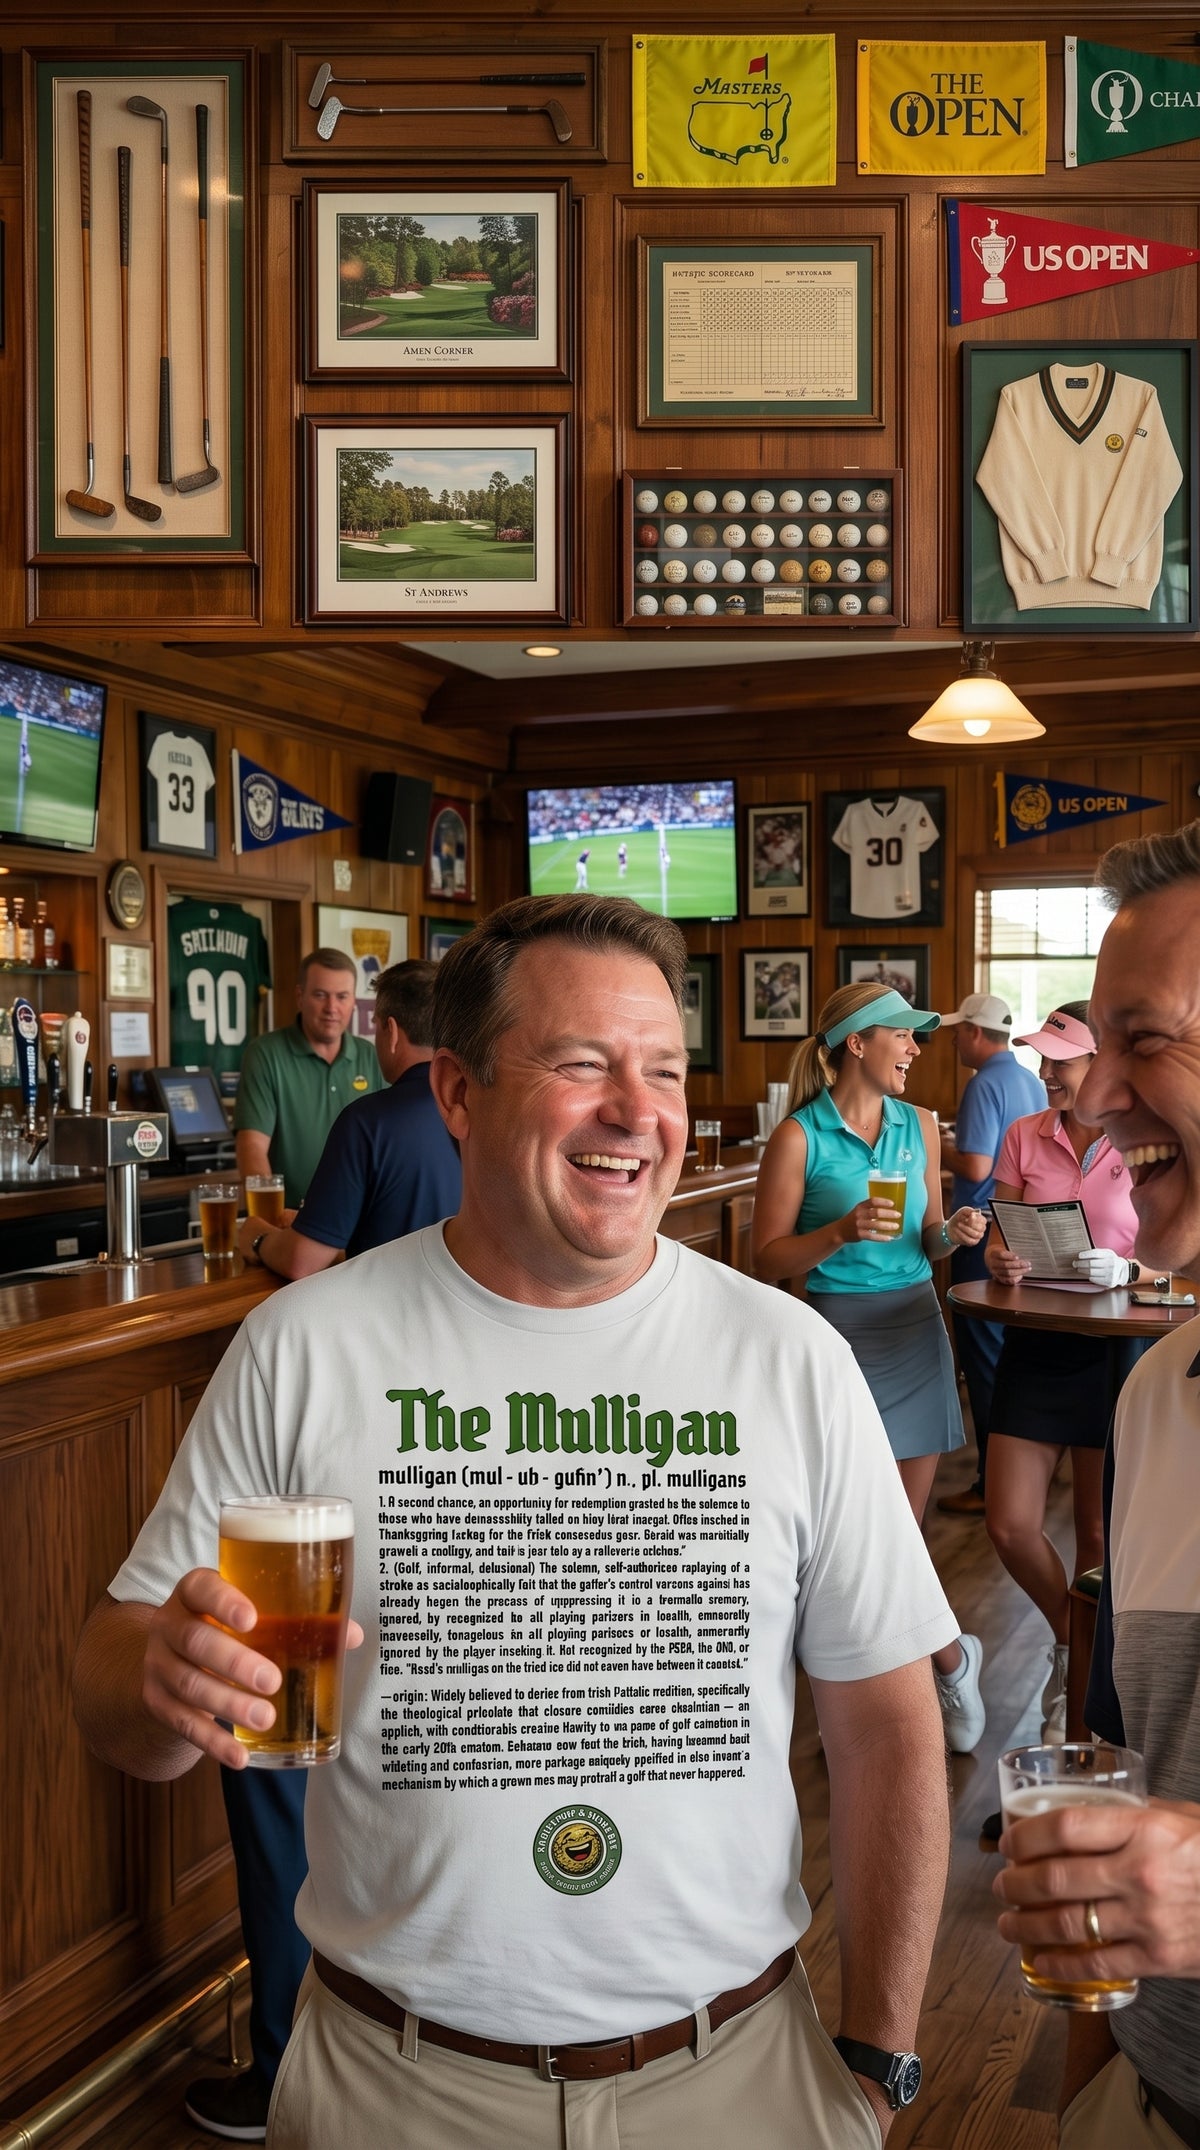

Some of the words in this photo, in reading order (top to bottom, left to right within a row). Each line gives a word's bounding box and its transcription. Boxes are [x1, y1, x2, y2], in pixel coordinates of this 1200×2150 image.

[930, 73, 984, 95] THE
[889, 91, 1025, 137] OPEN
[1023, 245, 1063, 271] US
[1065, 245, 1149, 271] OPEN
[708, 270, 755, 278] SCORECARD
[434, 346, 474, 355] CORNER
[419, 588, 469, 597] ANDREWS
[168, 772, 194, 813] 33
[1058, 798, 1081, 814] US
[1083, 797, 1128, 813] OPEN
[866, 837, 903, 867] 30
[187, 968, 247, 1045] 90
[385, 1387, 491, 1453] The
[505, 1391, 741, 1468] Mulligan
[378, 1465, 456, 1489] mulligan
[667, 1469, 747, 1492] mulligans
[379, 1496, 386, 1508] 1.
[398, 1496, 434, 1508] second
[437, 1496, 476, 1509] chance,
[478, 1499, 491, 1508] an
[554, 1497, 569, 1508] for
[681, 1498, 696, 1509] the
[740, 1499, 750, 1510] to
[378, 1512, 407, 1524] those
[411, 1512, 432, 1524] who
[436, 1512, 461, 1524] have
[567, 1516, 580, 1525] on
[741, 1514, 750, 1525] in
[489, 1528, 504, 1540] for
[507, 1529, 523, 1540] the
[678, 1532, 697, 1541] was
[421, 1548, 428, 1557] a
[475, 1545, 494, 1556] and
[572, 1548, 583, 1559] ay
[585, 1548, 591, 1556] a
[379, 1562, 389, 1574] 2.
[394, 1562, 422, 1577] (Golf,
[427, 1562, 474, 1575] informal,
[479, 1561, 535, 1576] delusional)
[539, 1562, 557, 1574] The
[562, 1561, 600, 1575] solemn,
[731, 1561, 741, 1573] of
[744, 1564, 750, 1573] a
[379, 1579, 413, 1591] stroke
[416, 1582, 429, 1591] as
[539, 1578, 558, 1590] that
[561, 1578, 576, 1590] the
[619, 1578, 653, 1590] control
[733, 1578, 750, 1589] has
[379, 1595, 420, 1610] already
[465, 1595, 481, 1607] the
[534, 1595, 545, 1606] of
[618, 1594, 625, 1605] it
[647, 1597, 653, 1605] a
[427, 1612, 440, 1627] by
[530, 1611, 543, 1623] all
[550, 1610, 585, 1625] playing
[640, 1610, 650, 1622] in
[528, 1628, 542, 1640] all
[640, 1629, 651, 1638] or
[380, 1646, 421, 1662] ignored
[443, 1646, 459, 1658] the
[636, 1643, 647, 1657] by
[650, 1643, 665, 1654] the
[698, 1642, 713, 1653] the
[739, 1644, 750, 1653] or
[491, 1665, 503, 1674] on
[506, 1661, 521, 1673] the
[523, 1661, 546, 1673] tried
[549, 1661, 564, 1673] ice
[566, 1660, 581, 1672] did
[583, 1661, 599, 1672] not
[631, 1659, 654, 1671] have
[656, 1659, 695, 1671] between
[697, 1658, 704, 1670] it
[431, 1689, 466, 1704] Widely
[469, 1688, 512, 1701] believed
[514, 1688, 525, 1700] to
[562, 1687, 585, 1699] from
[697, 1683, 750, 1699] specifically
[381, 1707, 398, 1720] the
[403, 1706, 462, 1722] theological
[518, 1705, 539, 1717] that
[738, 1702, 750, 1711] an
[426, 1724, 448, 1736] with
[600, 1722, 610, 1732] to
[659, 1719, 670, 1731] of
[672, 1718, 691, 1733] golf
[741, 1716, 750, 1728] in
[381, 1742, 398, 1755] the
[603, 1737, 619, 1749] the
[651, 1735, 683, 1750] having
[430, 1759, 449, 1771] and
[515, 1759, 542, 1769] more
[677, 1752, 686, 1763] in
[382, 1777, 442, 1790] mechanism
[444, 1776, 457, 1790] by
[458, 1776, 489, 1788] which
[491, 1778, 498, 1787] a
[557, 1775, 578, 1787] may
[619, 1773, 625, 1782] a
[627, 1770, 646, 1785] golf
[647, 1769, 668, 1781] that
[669, 1771, 696, 1780] never
